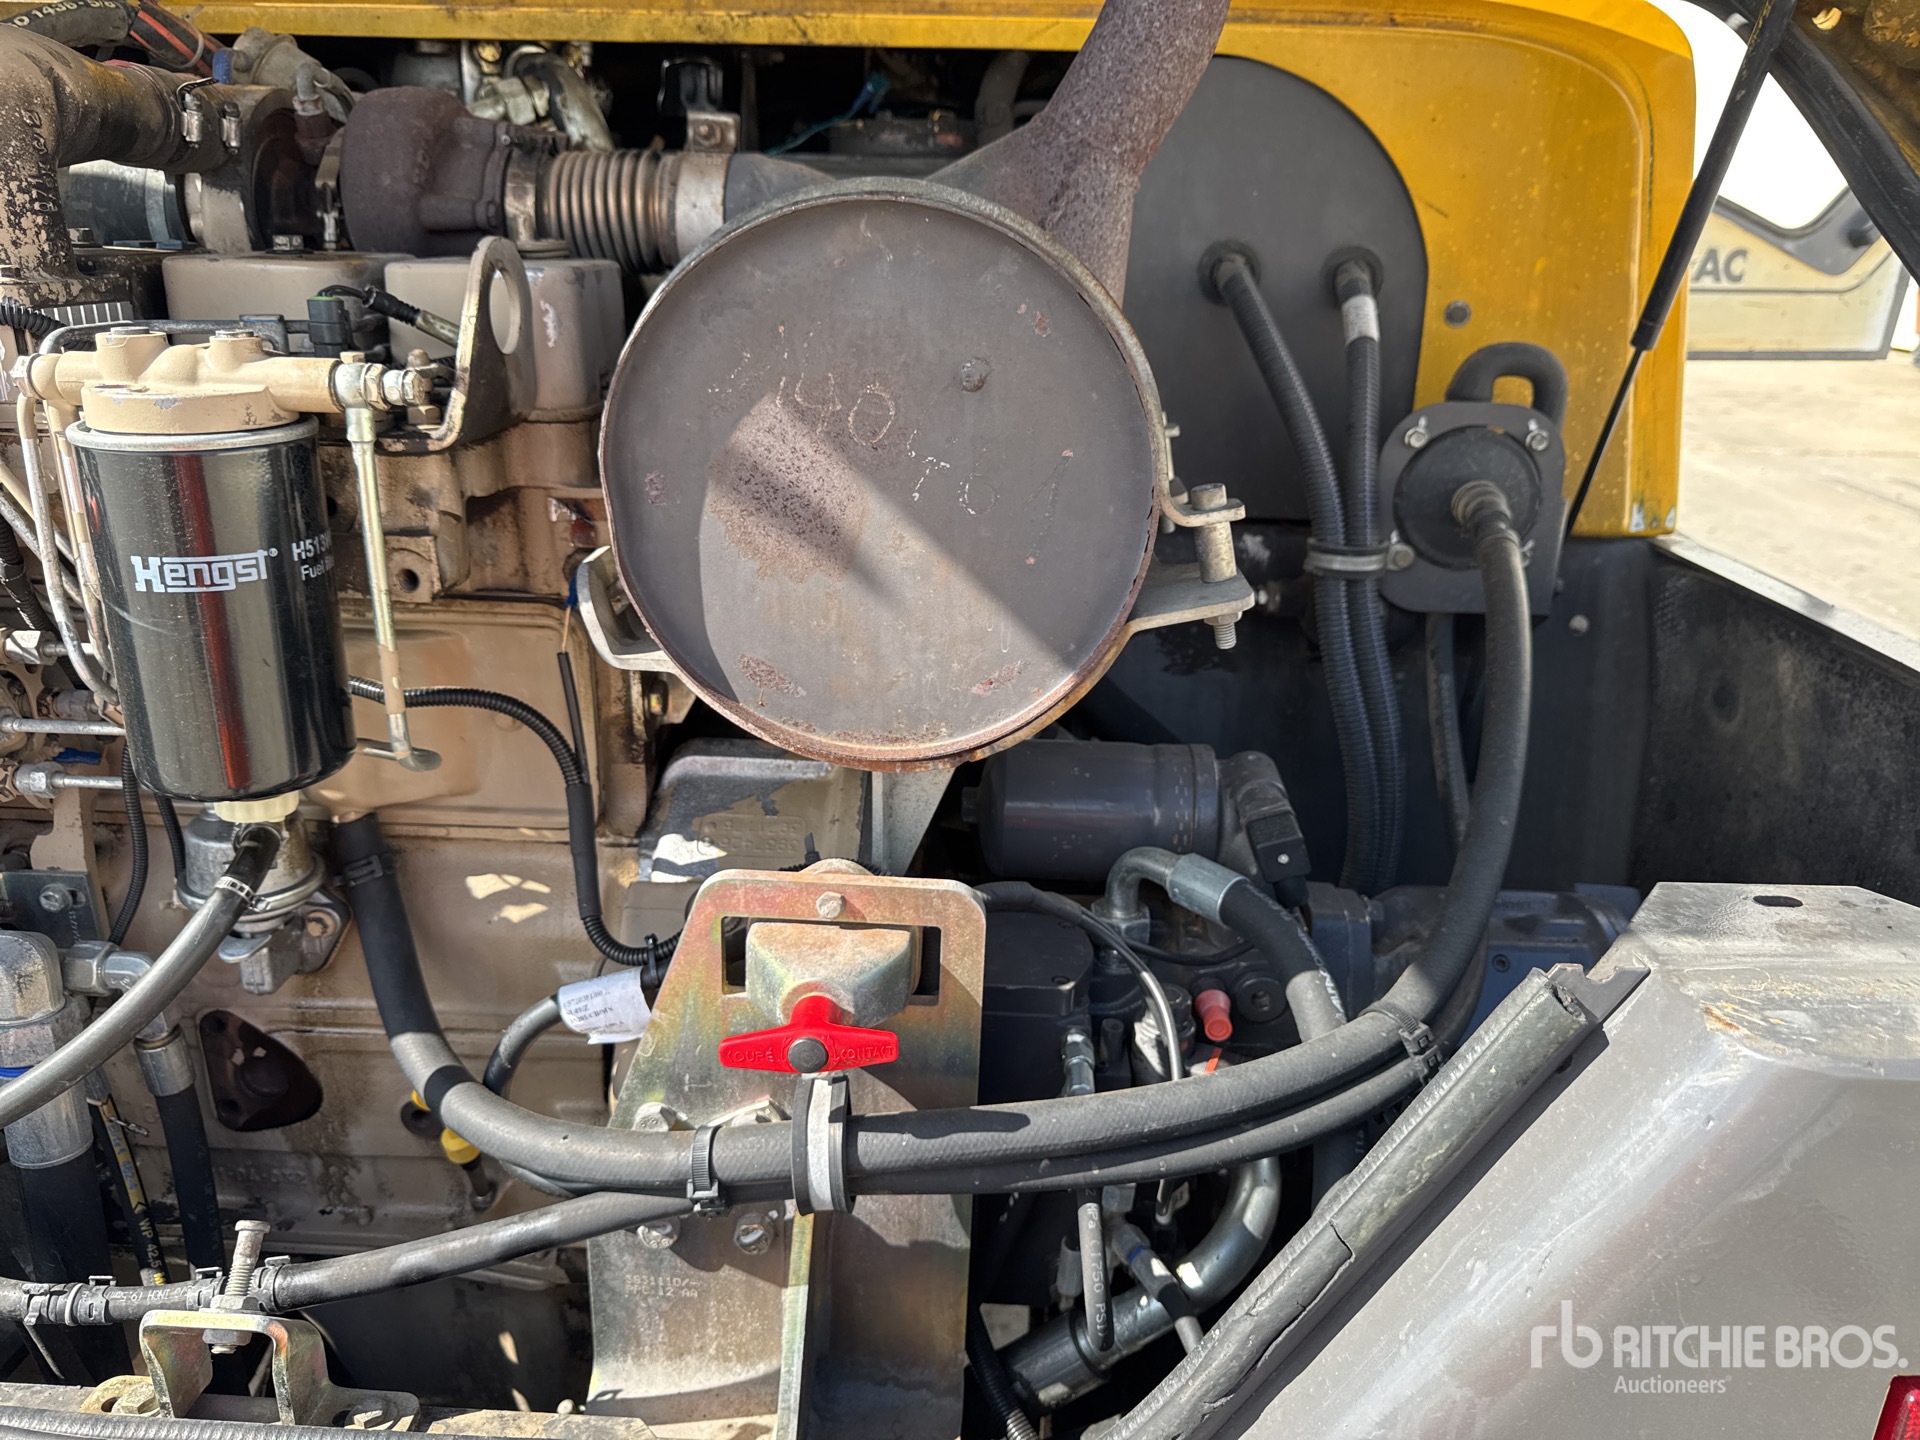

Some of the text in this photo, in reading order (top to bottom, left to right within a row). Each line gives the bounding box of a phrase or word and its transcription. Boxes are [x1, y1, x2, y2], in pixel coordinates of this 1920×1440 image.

[130, 549, 269, 593] Hengst
[300, 559, 326, 582] Fuel
[840, 1045, 893, 1060] CONTACT
[138, 1217, 154, 1239] WP
[1086, 1203, 1099, 1230] MPa
